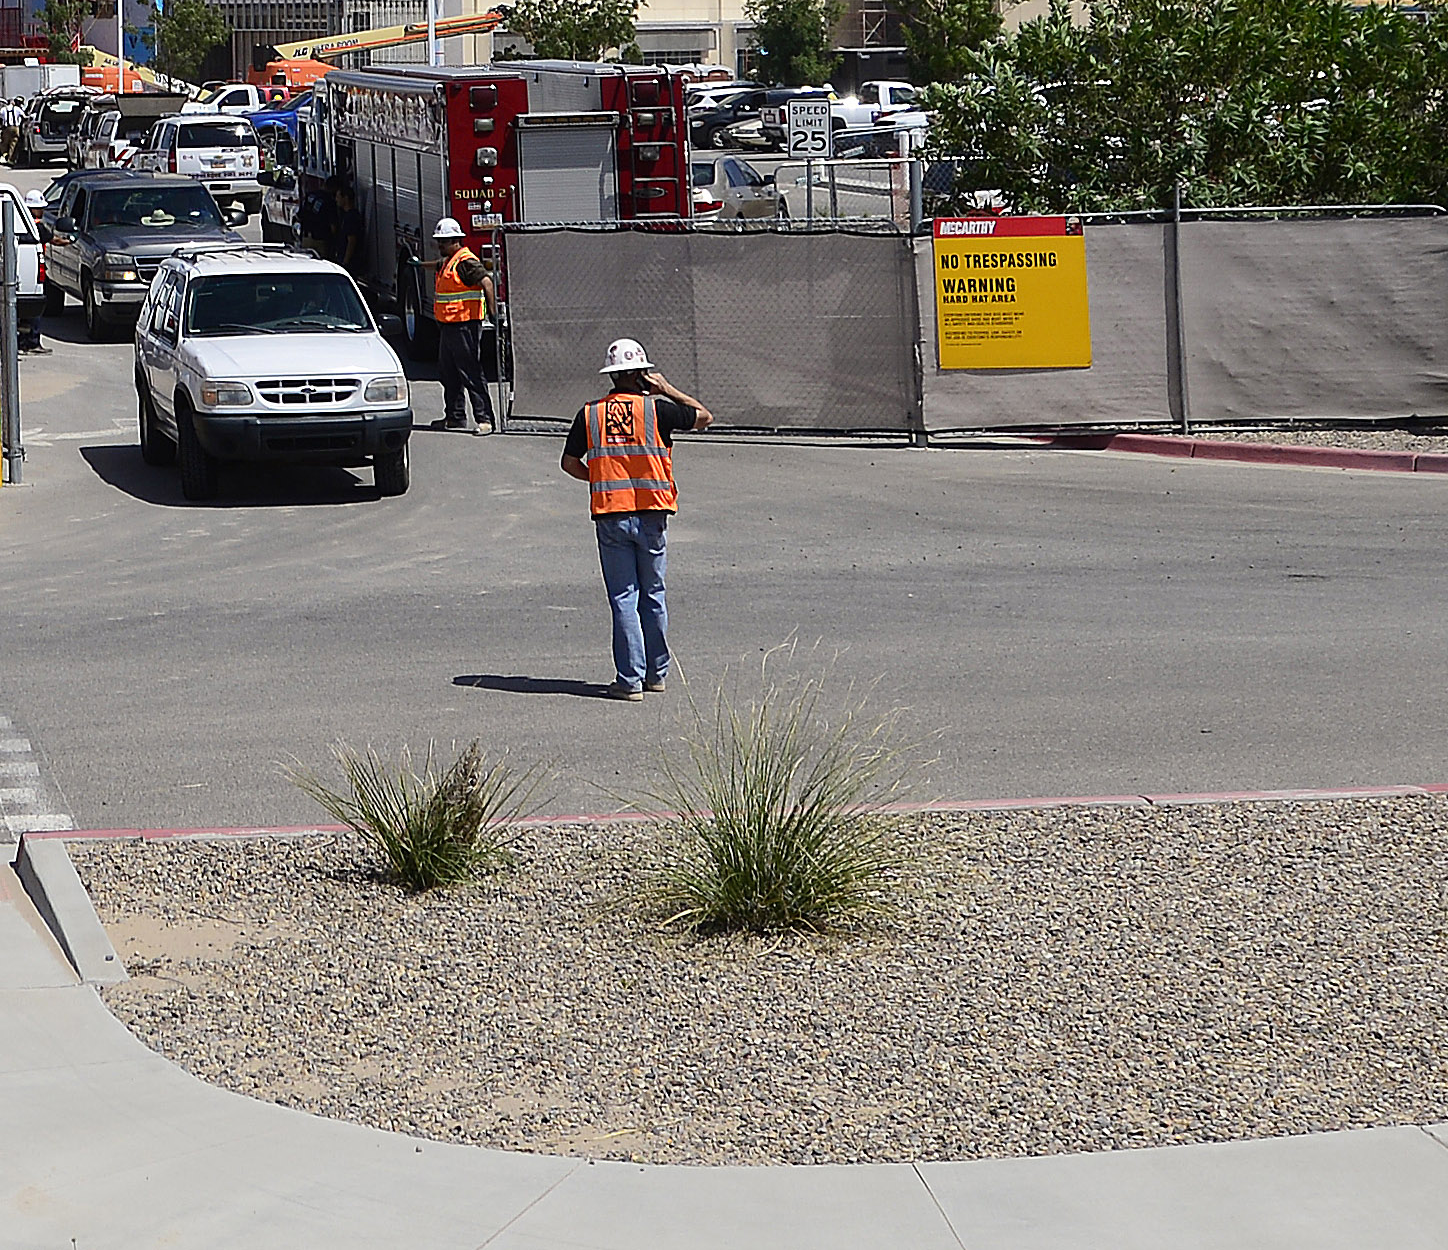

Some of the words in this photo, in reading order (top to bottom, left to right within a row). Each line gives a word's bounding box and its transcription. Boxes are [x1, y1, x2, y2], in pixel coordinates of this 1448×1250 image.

[792, 106, 828, 115] SPEED
[795, 119, 823, 127] LIMIT
[792, 131, 827, 151] 25
[455, 189, 494, 199] SQUAD
[498, 188, 506, 198] 2
[941, 254, 958, 269] NO
[964, 252, 1057, 268] TRESPASSING
[942, 278, 1016, 293] WARNING
[943, 295, 968, 304] HARD
[971, 295, 988, 303] HAT
[991, 294, 1016, 303] AREA
